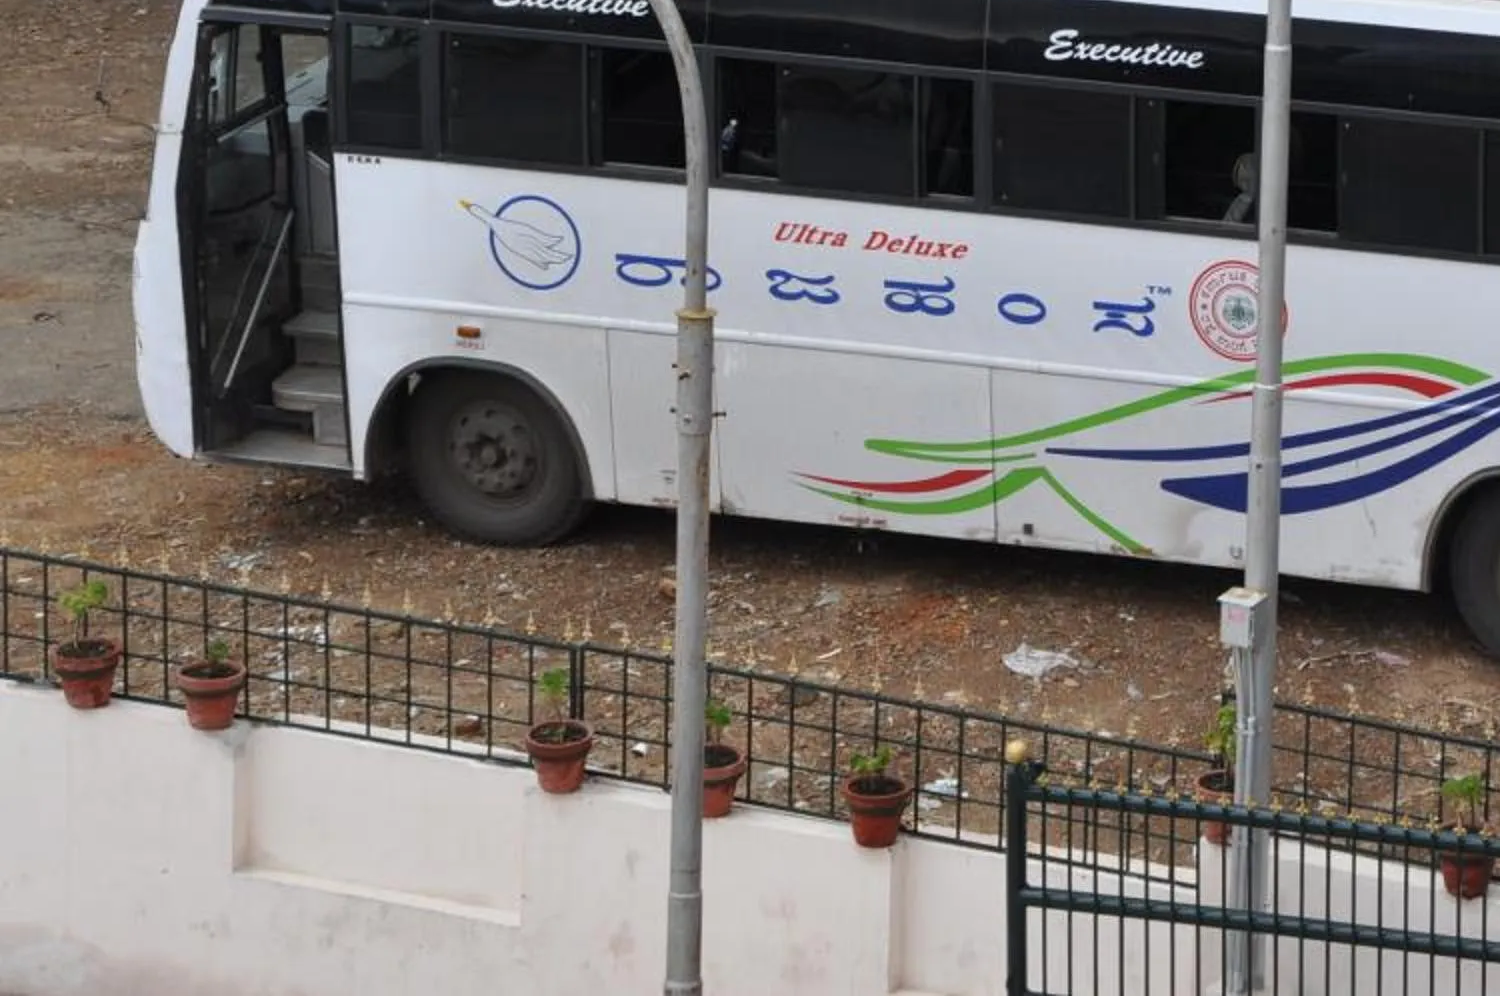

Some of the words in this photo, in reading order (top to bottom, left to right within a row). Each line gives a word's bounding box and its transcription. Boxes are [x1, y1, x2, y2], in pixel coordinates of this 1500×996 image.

[1043, 28, 1205, 69] Executive
[774, 221, 849, 249] Ultra
[863, 229, 970, 260] Deluxe
